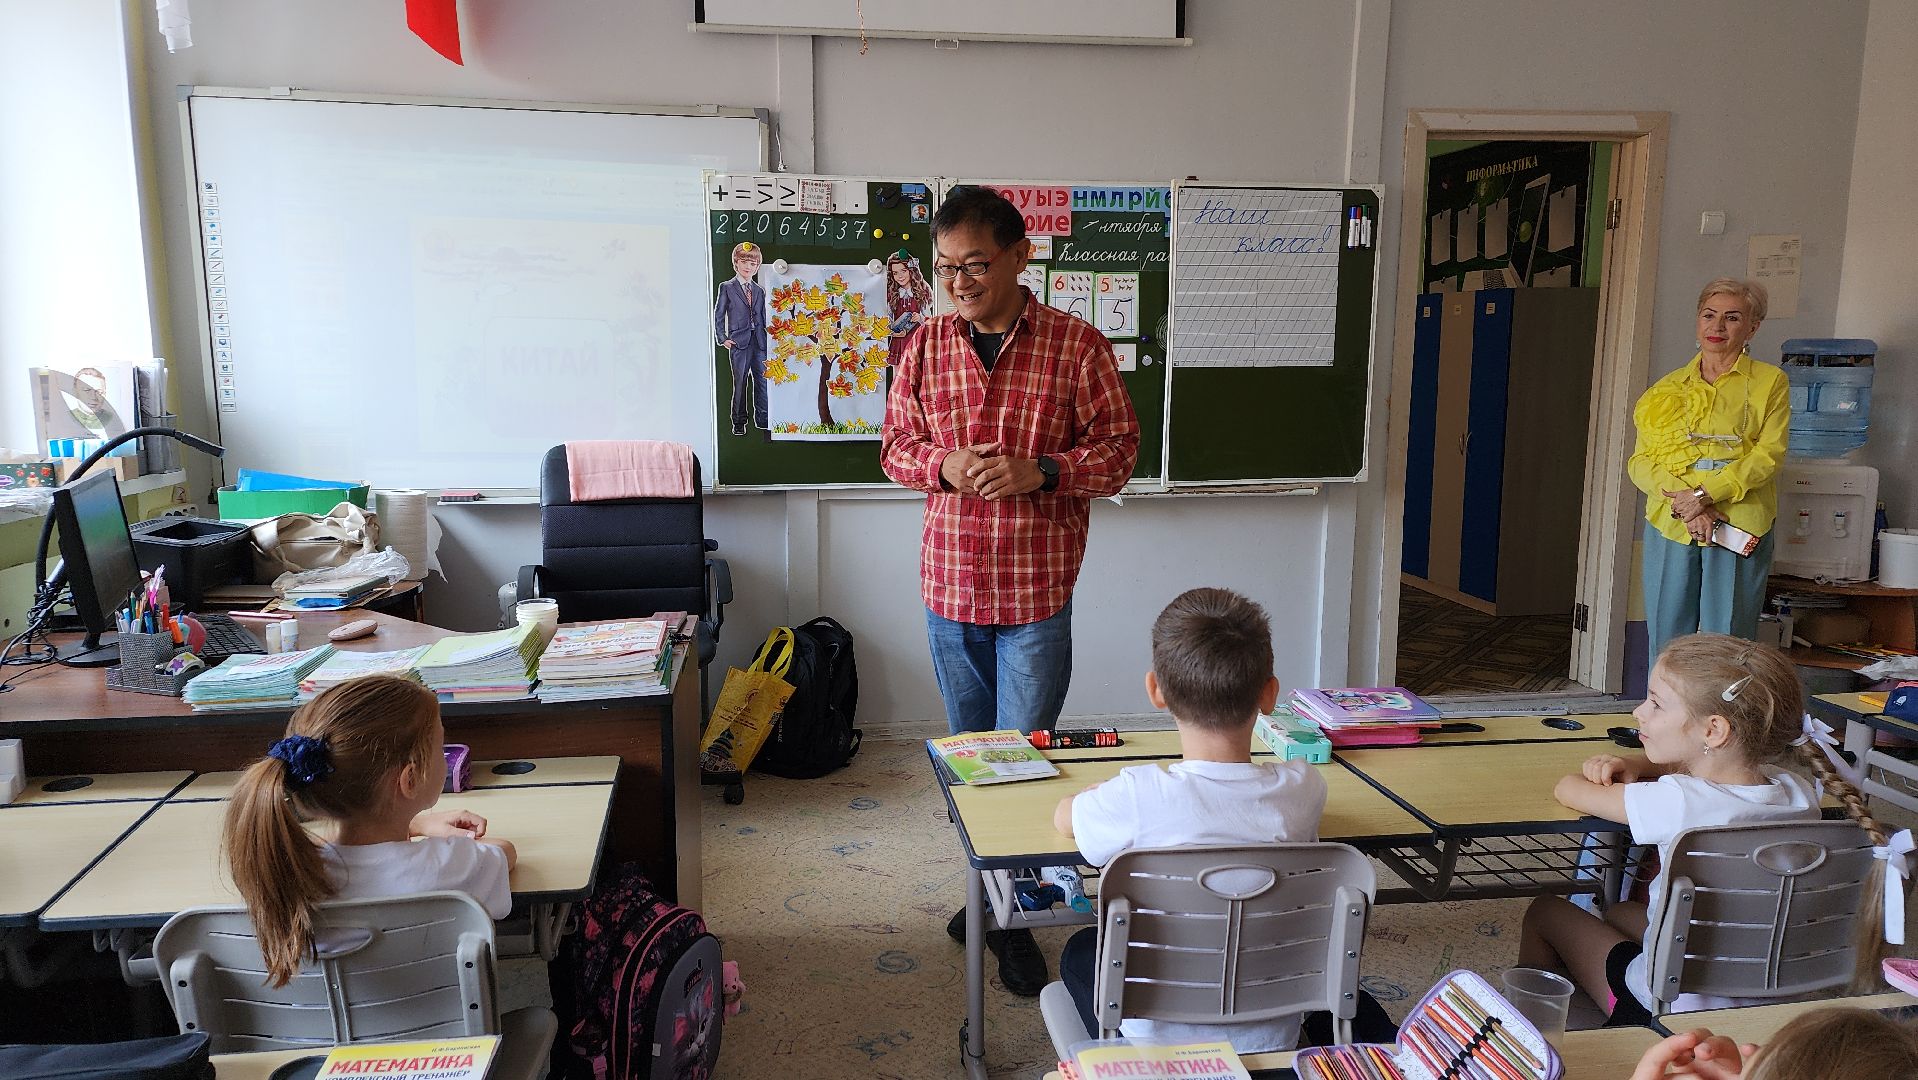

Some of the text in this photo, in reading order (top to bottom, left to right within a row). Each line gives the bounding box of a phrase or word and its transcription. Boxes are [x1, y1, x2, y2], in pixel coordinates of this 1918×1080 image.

[1466, 155, 1538, 182] ИНФОРМАТИКА
[1195, 200, 1270, 225] Наш
[1058, 242, 1170, 270] Классная ра
[1054, 276, 1065, 291] 6
[1101, 278, 1110, 292] 5
[1108, 298, 1132, 331] 5
[943, 736, 1018, 748] МАТЕМАТИКА
[328, 1054, 474, 1074] МАТЕМАТИКА
[1093, 1057, 1232, 1077] МАТЕМАТИКА
